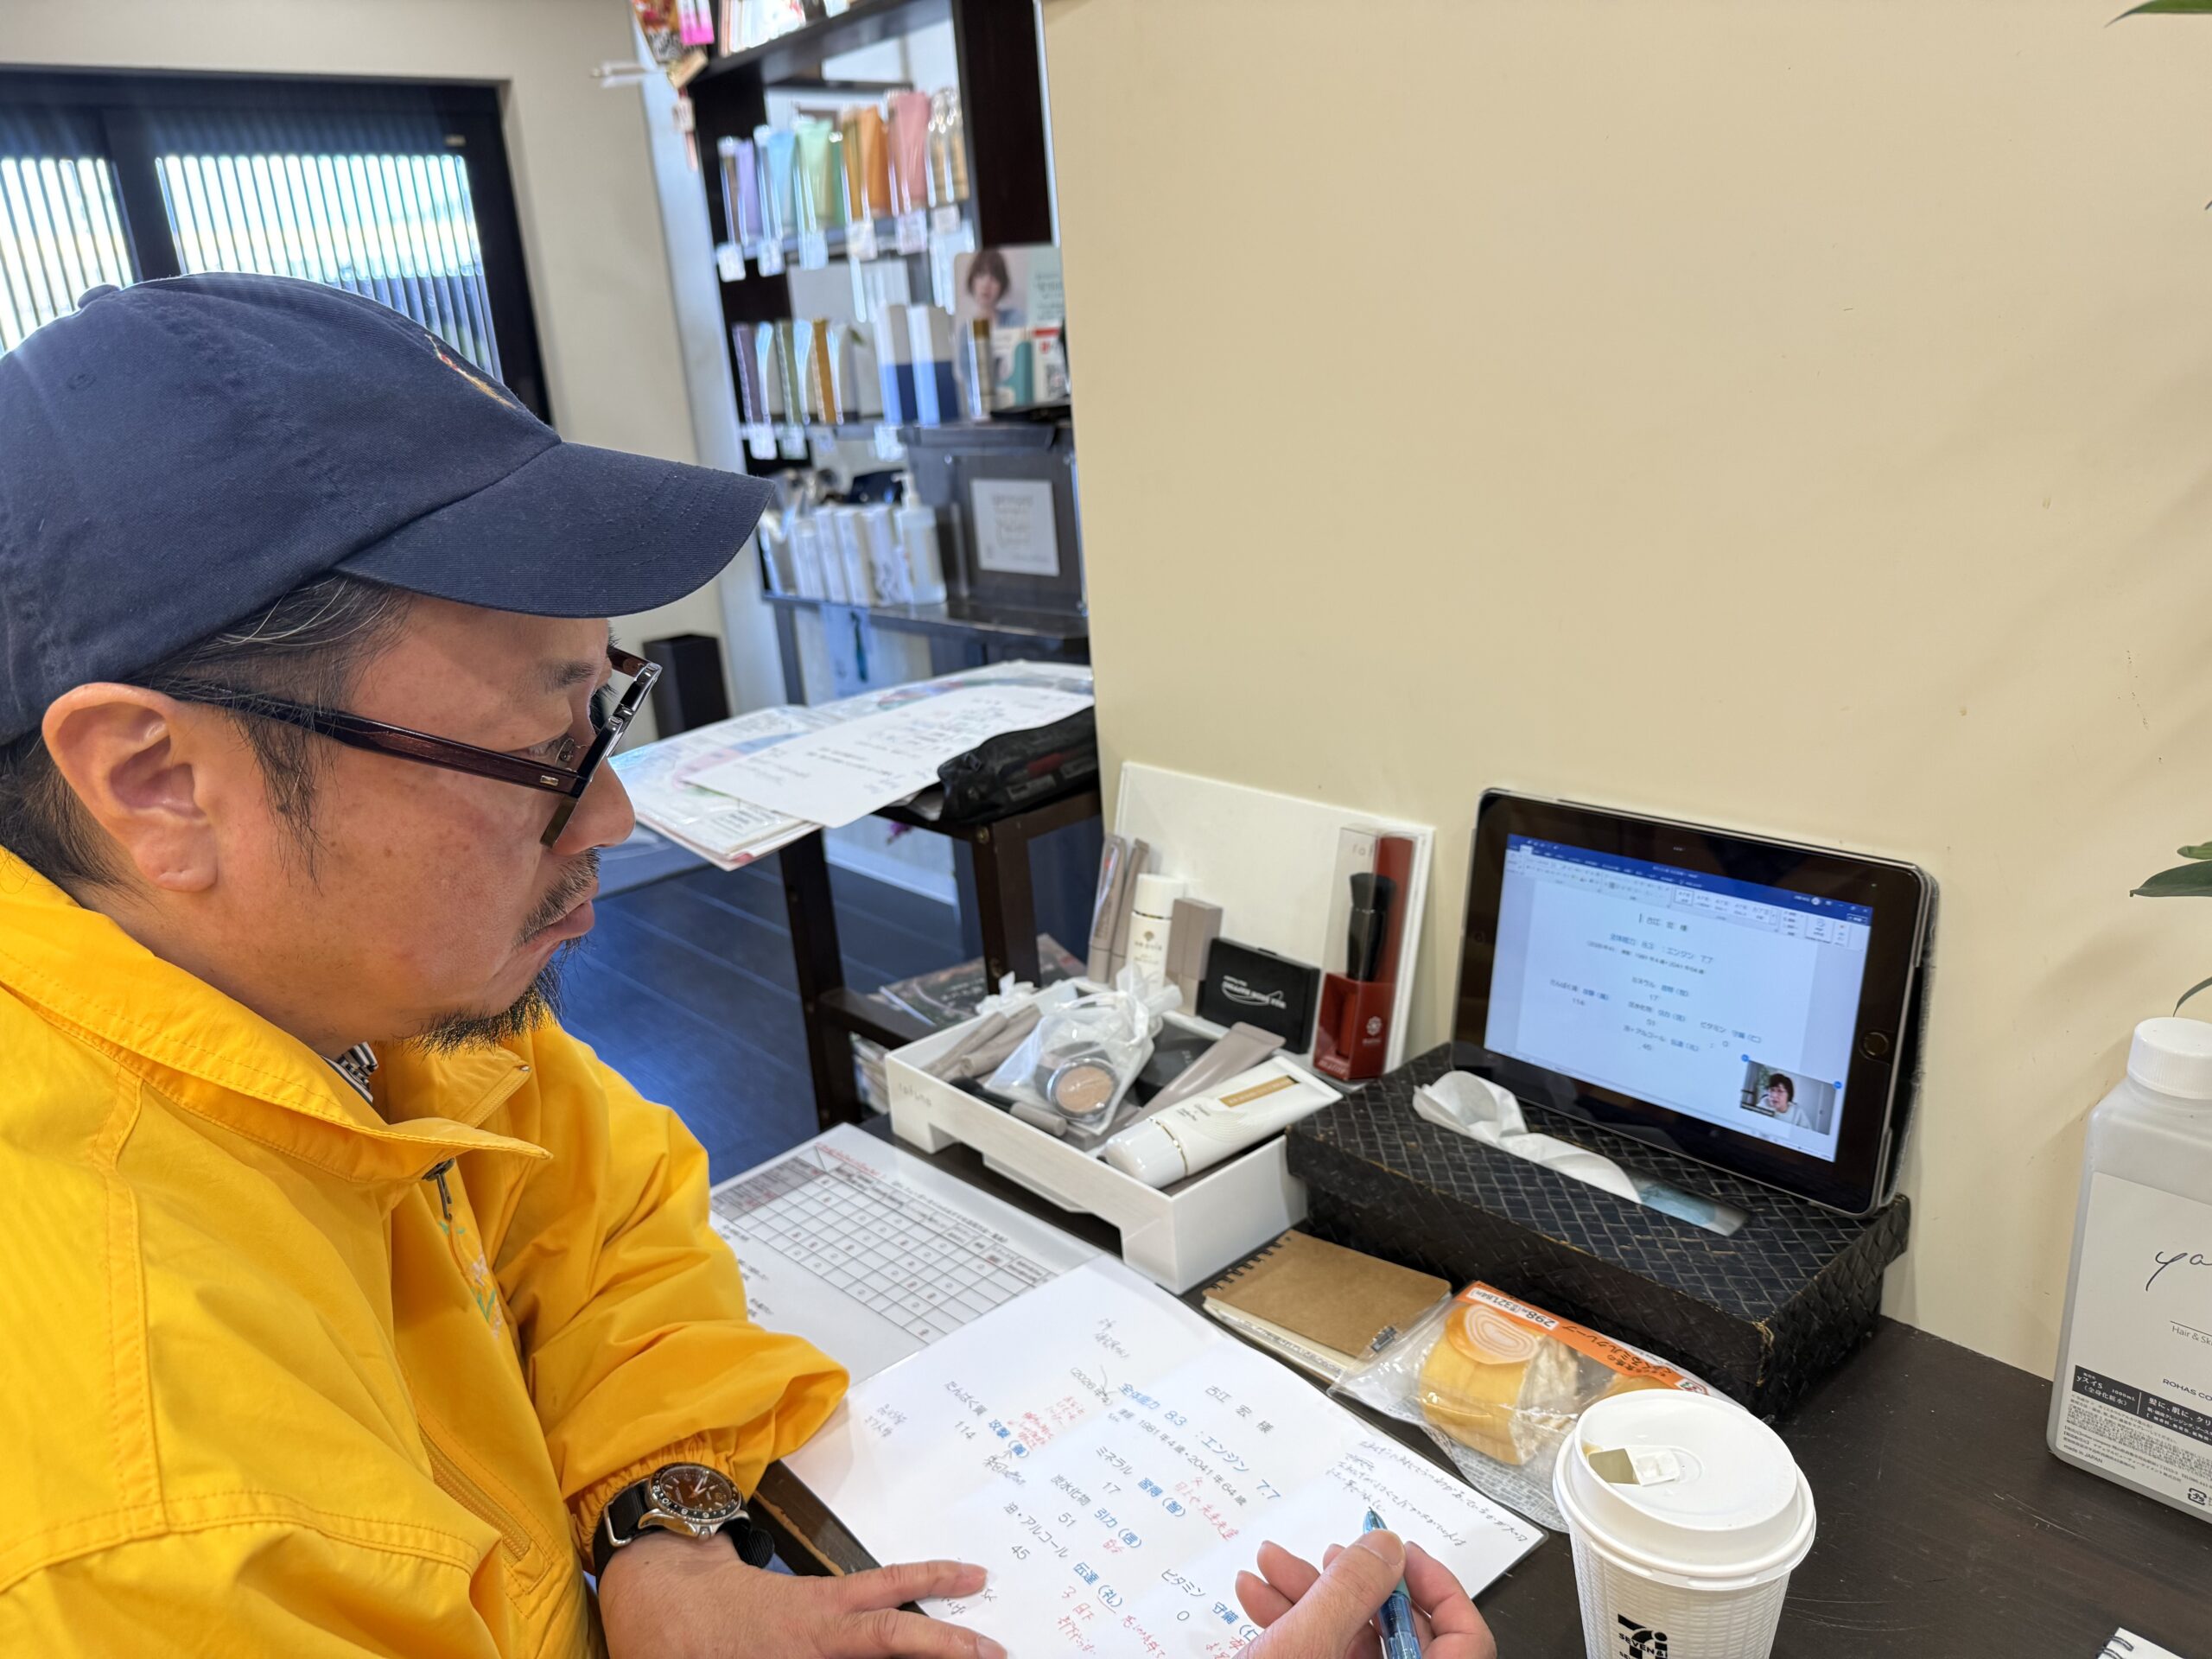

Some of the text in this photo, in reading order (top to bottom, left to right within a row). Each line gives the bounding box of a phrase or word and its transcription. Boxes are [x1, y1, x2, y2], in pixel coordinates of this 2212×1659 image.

[2172, 1325, 2190, 1338] Hair
[2191, 1333, 2199, 1342] &
[2163, 1378, 2197, 1396] ROHAS
[1205, 1384, 1274, 1434] 古江 宏 様
[954, 1420, 977, 1441] 114
[1096, 1445, 1133, 1477] ミネラル
[1164, 1409, 1187, 1427] 8.3
[1254, 1478, 1281, 1502] 7.7
[2084, 1452, 2104, 1465] JAPAN
[1050, 1472, 1092, 1508] 炭水化物
[1102, 1481, 1122, 1495] 17
[1002, 1500, 1069, 1560] 油・アルコール
[1058, 1511, 1077, 1528] 51
[1011, 1544, 1031, 1560] 45
[1160, 1568, 1207, 1599] ビタミン
